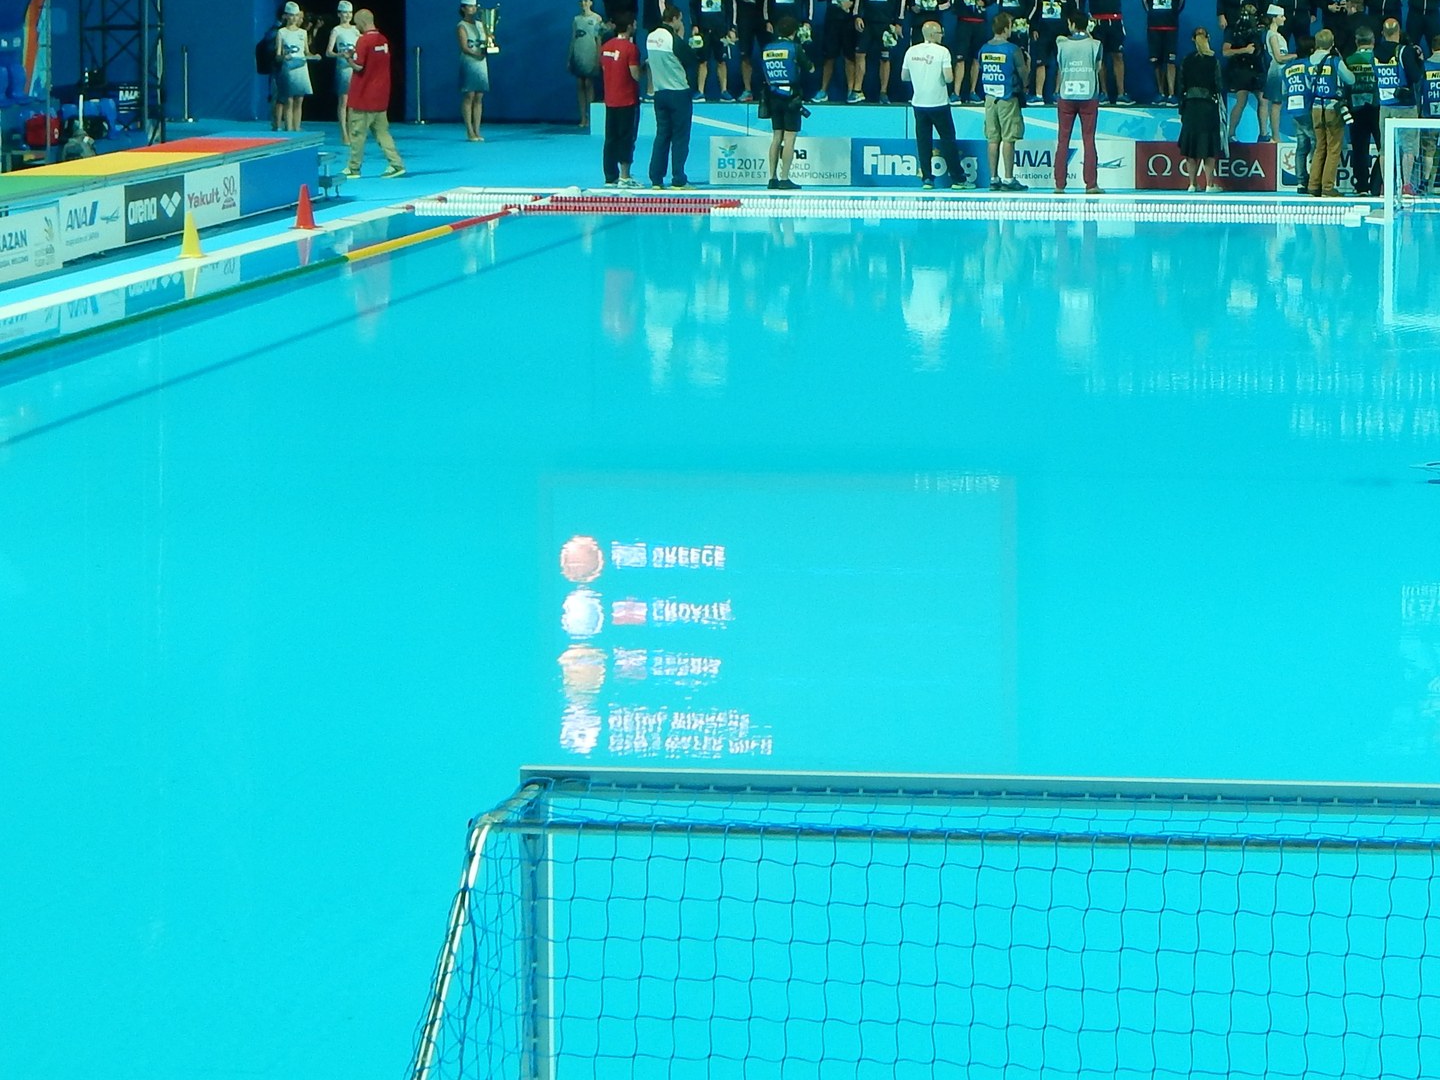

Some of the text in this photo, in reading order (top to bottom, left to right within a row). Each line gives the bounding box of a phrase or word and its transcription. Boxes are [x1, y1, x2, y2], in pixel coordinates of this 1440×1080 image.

[766, 61, 786, 70] POOL
[983, 64, 1003, 73] POOL
[982, 73, 1005, 82] PHOTO
[737, 158, 765, 170] 2017
[717, 171, 767, 179] BUDAPEST
[187, 187, 221, 209] Yakult
[65, 206, 88, 231] ANA
[0, 229, 28, 252] AZAN
